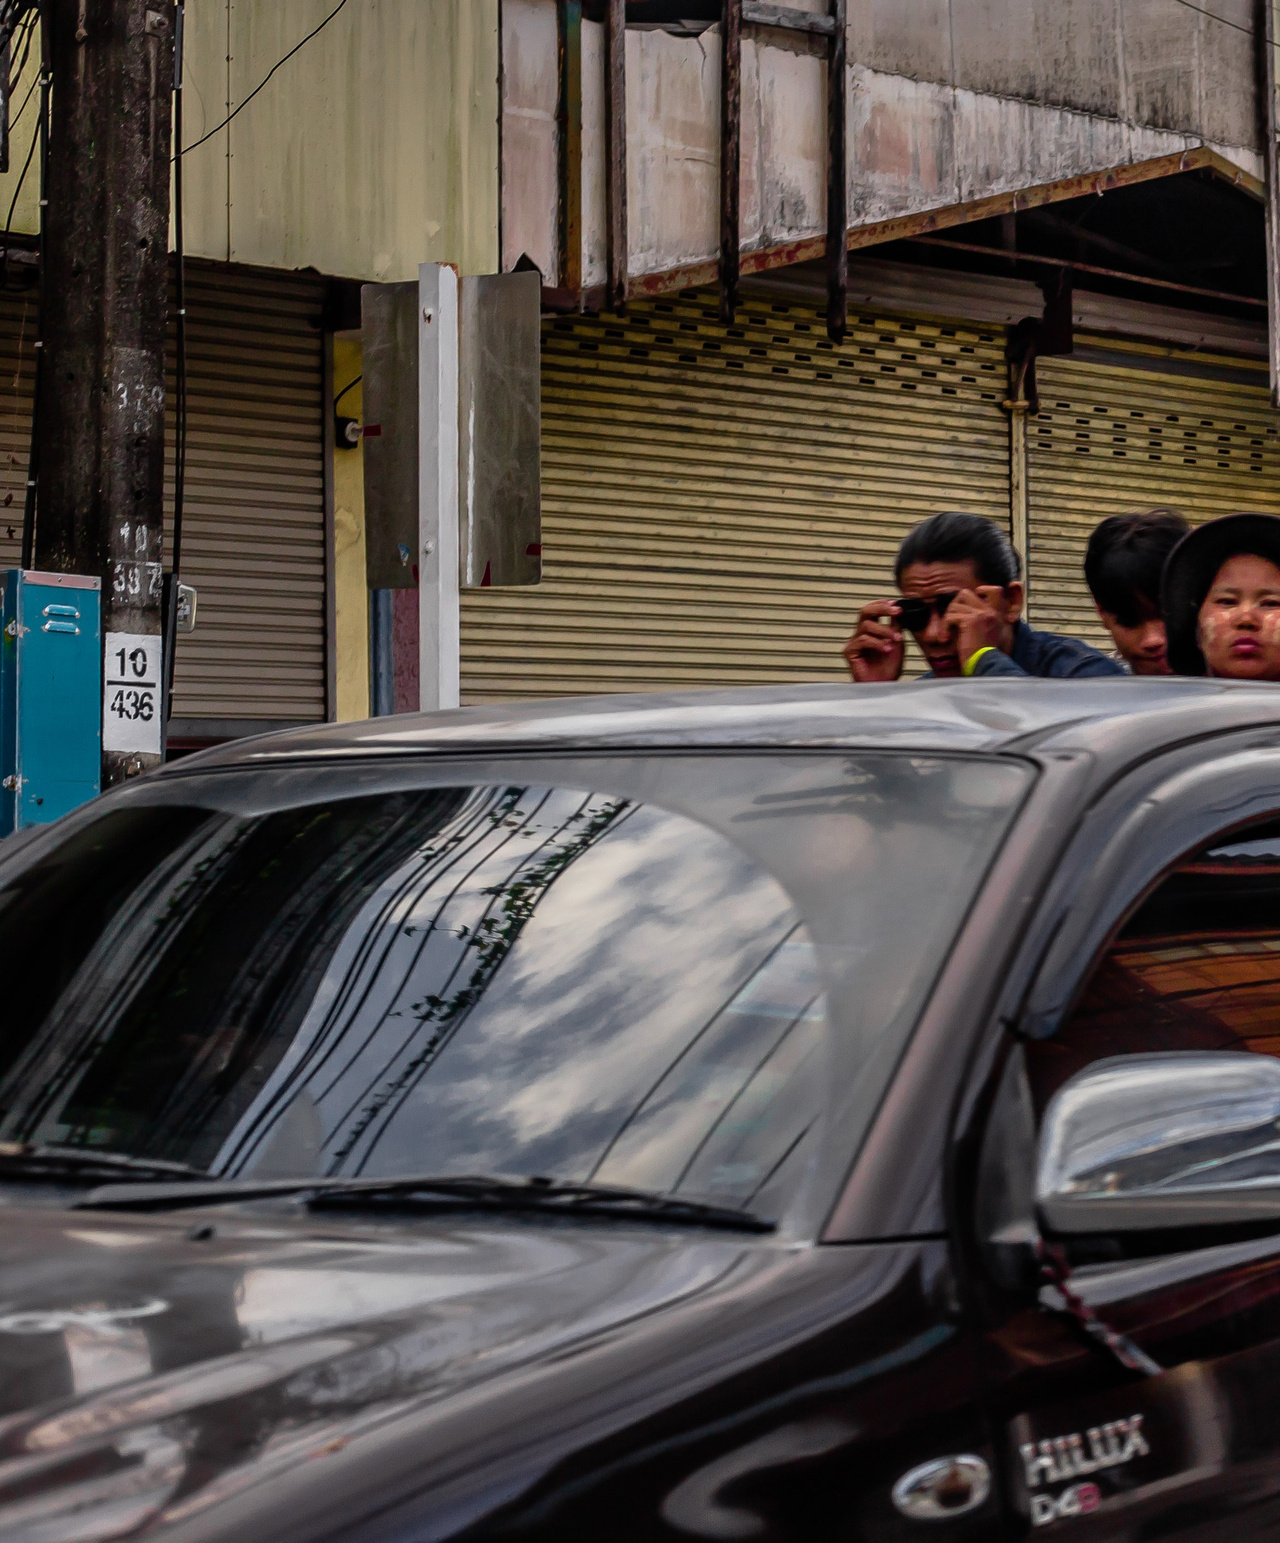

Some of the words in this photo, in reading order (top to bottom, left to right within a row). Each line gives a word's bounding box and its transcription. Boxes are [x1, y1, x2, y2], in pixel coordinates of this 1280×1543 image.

[115, 647, 148, 678] 10
[110, 690, 154, 722] 436
[1019, 1413, 1150, 1488] HILUX
